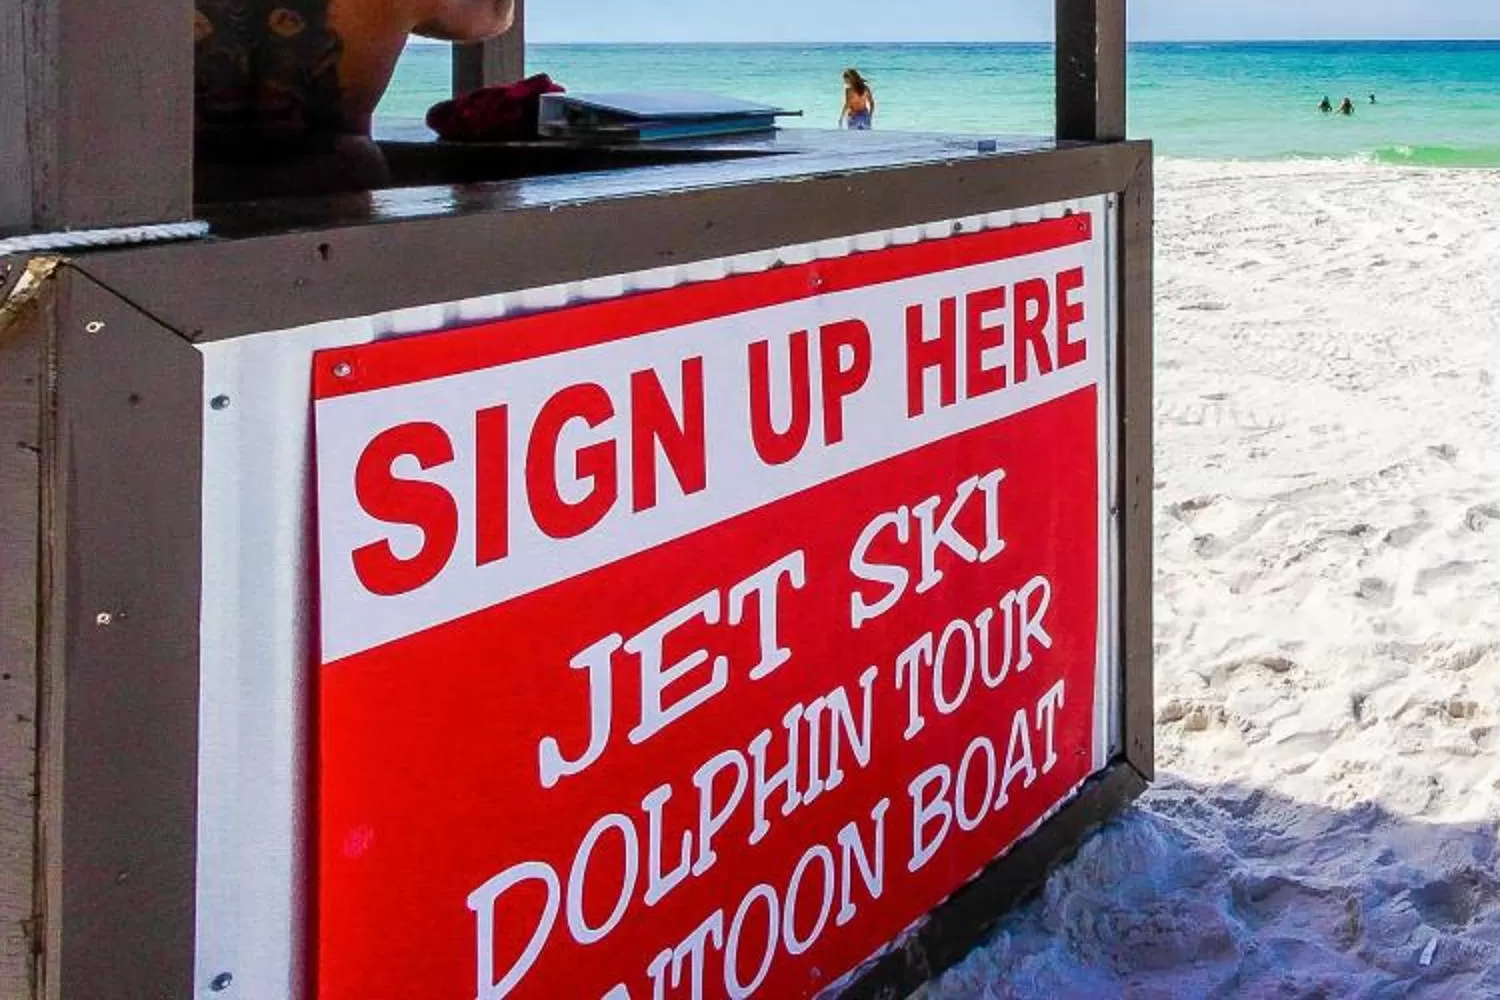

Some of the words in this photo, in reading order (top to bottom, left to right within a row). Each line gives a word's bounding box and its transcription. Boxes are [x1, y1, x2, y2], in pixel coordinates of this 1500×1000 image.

[350, 357, 706, 597] SIGN
[748, 318, 872, 465] UP
[906, 266, 1087, 419] HERE
[466, 665, 878, 1000] DOLPHIN
[894, 575, 1053, 741] TOUR
[538, 551, 806, 788] JET
[850, 468, 1006, 628] SKI
[600, 799, 888, 1000] TOON
[908, 680, 1065, 872] BOAT
